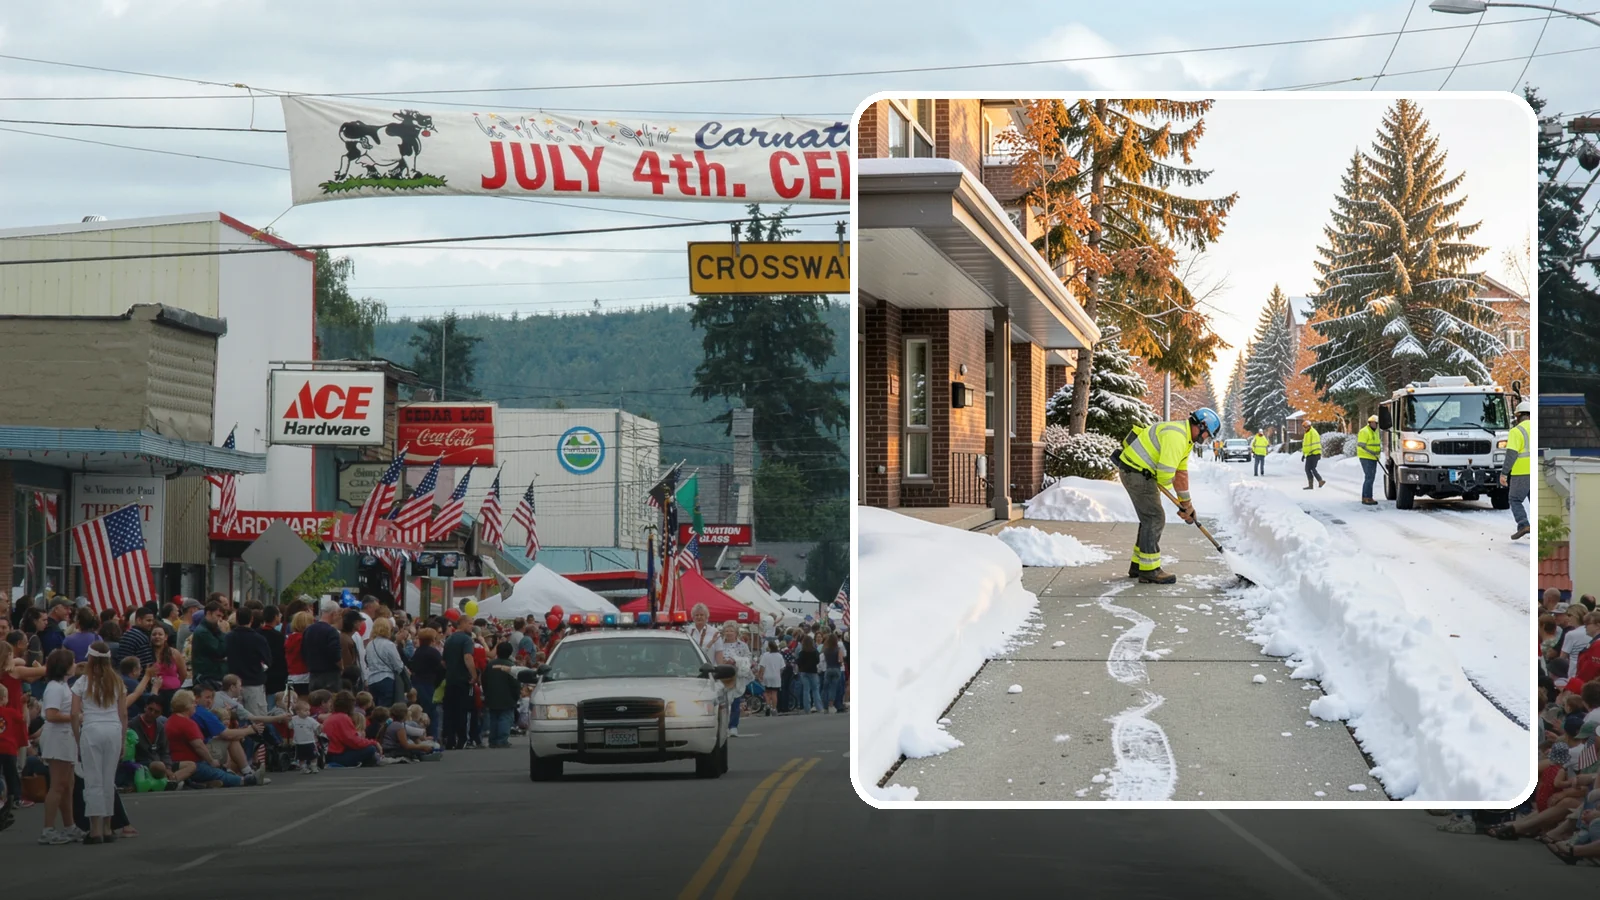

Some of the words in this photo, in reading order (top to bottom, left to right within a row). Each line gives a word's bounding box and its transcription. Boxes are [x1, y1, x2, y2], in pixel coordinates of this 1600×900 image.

[694, 121, 850, 150] Carnat
[481, 141, 605, 192] JULY
[632, 150, 747, 198] 4th.
[696, 253, 850, 280] CROSSWA
[282, 380, 374, 420] ACE
[404, 408, 452, 422] CEDAR
[460, 408, 485, 422] LOG
[283, 421, 371, 436] Hardware
[416, 428, 477, 447] Coca-Cola
[353, 467, 385, 480] Simpl
[95, 485, 124, 495] Vincent
[126, 486, 136, 495] de
[137, 486, 155, 495] Paul
[81, 503, 154, 522] THT
[212, 515, 331, 535] HARDARE
[687, 526, 741, 536] CRNATION
[699, 535, 730, 544] GLASS
